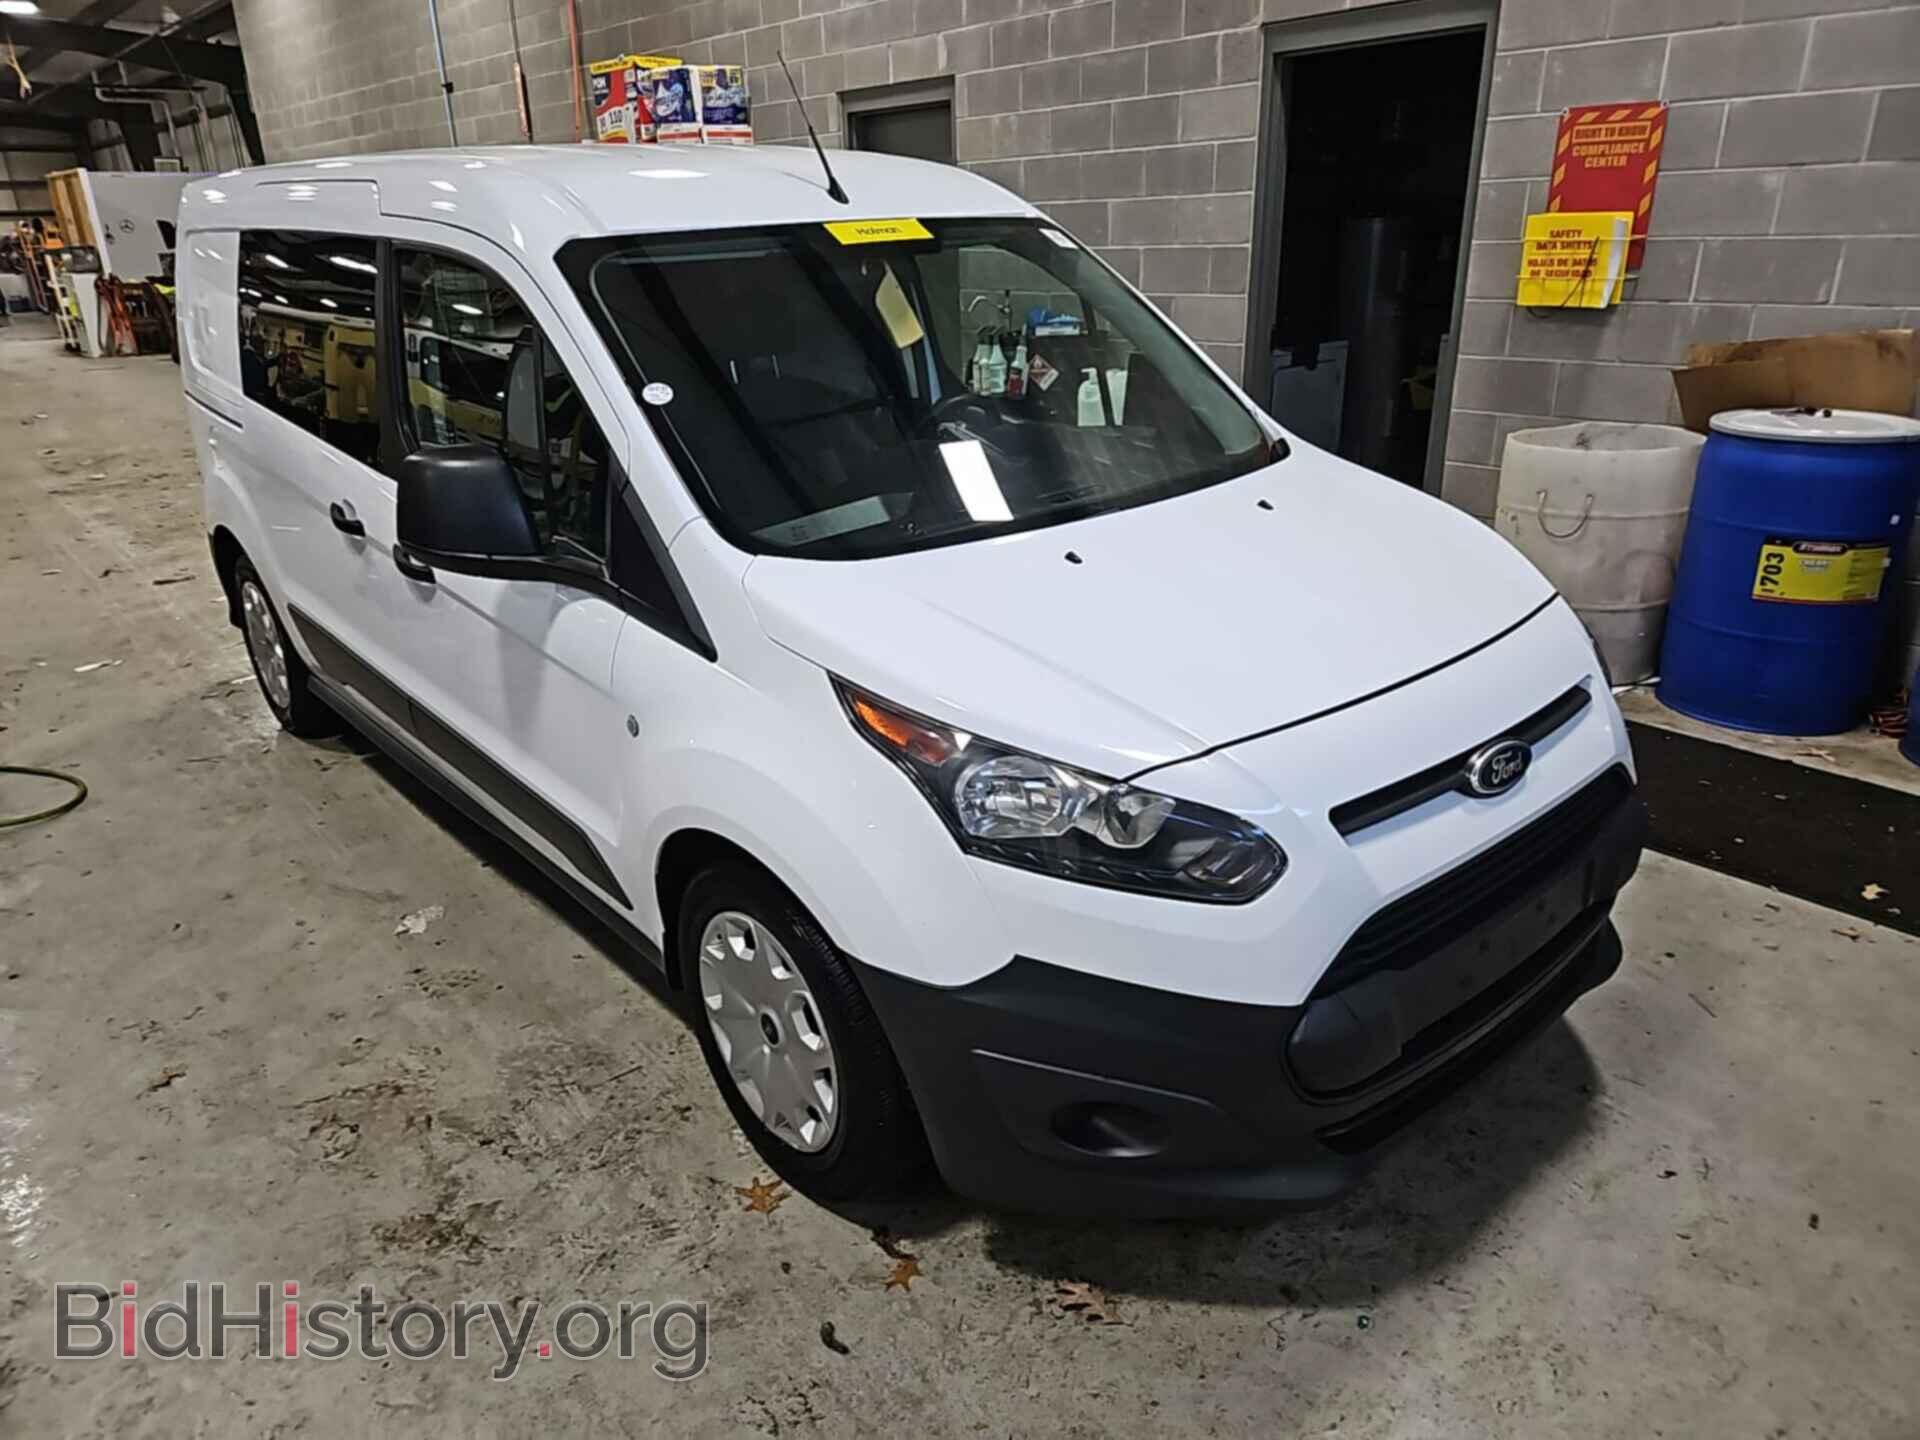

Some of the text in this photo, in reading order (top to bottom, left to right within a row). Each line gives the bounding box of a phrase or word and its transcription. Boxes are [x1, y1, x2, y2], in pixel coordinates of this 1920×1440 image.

[1572, 142, 1646, 157] COMPLIANCE
[1584, 156, 1628, 168] CENTER
[1550, 229, 1583, 238] SAFETY
[1536, 240, 1593, 250] DATA SHEETS
[1491, 750, 1522, 785] Ford
